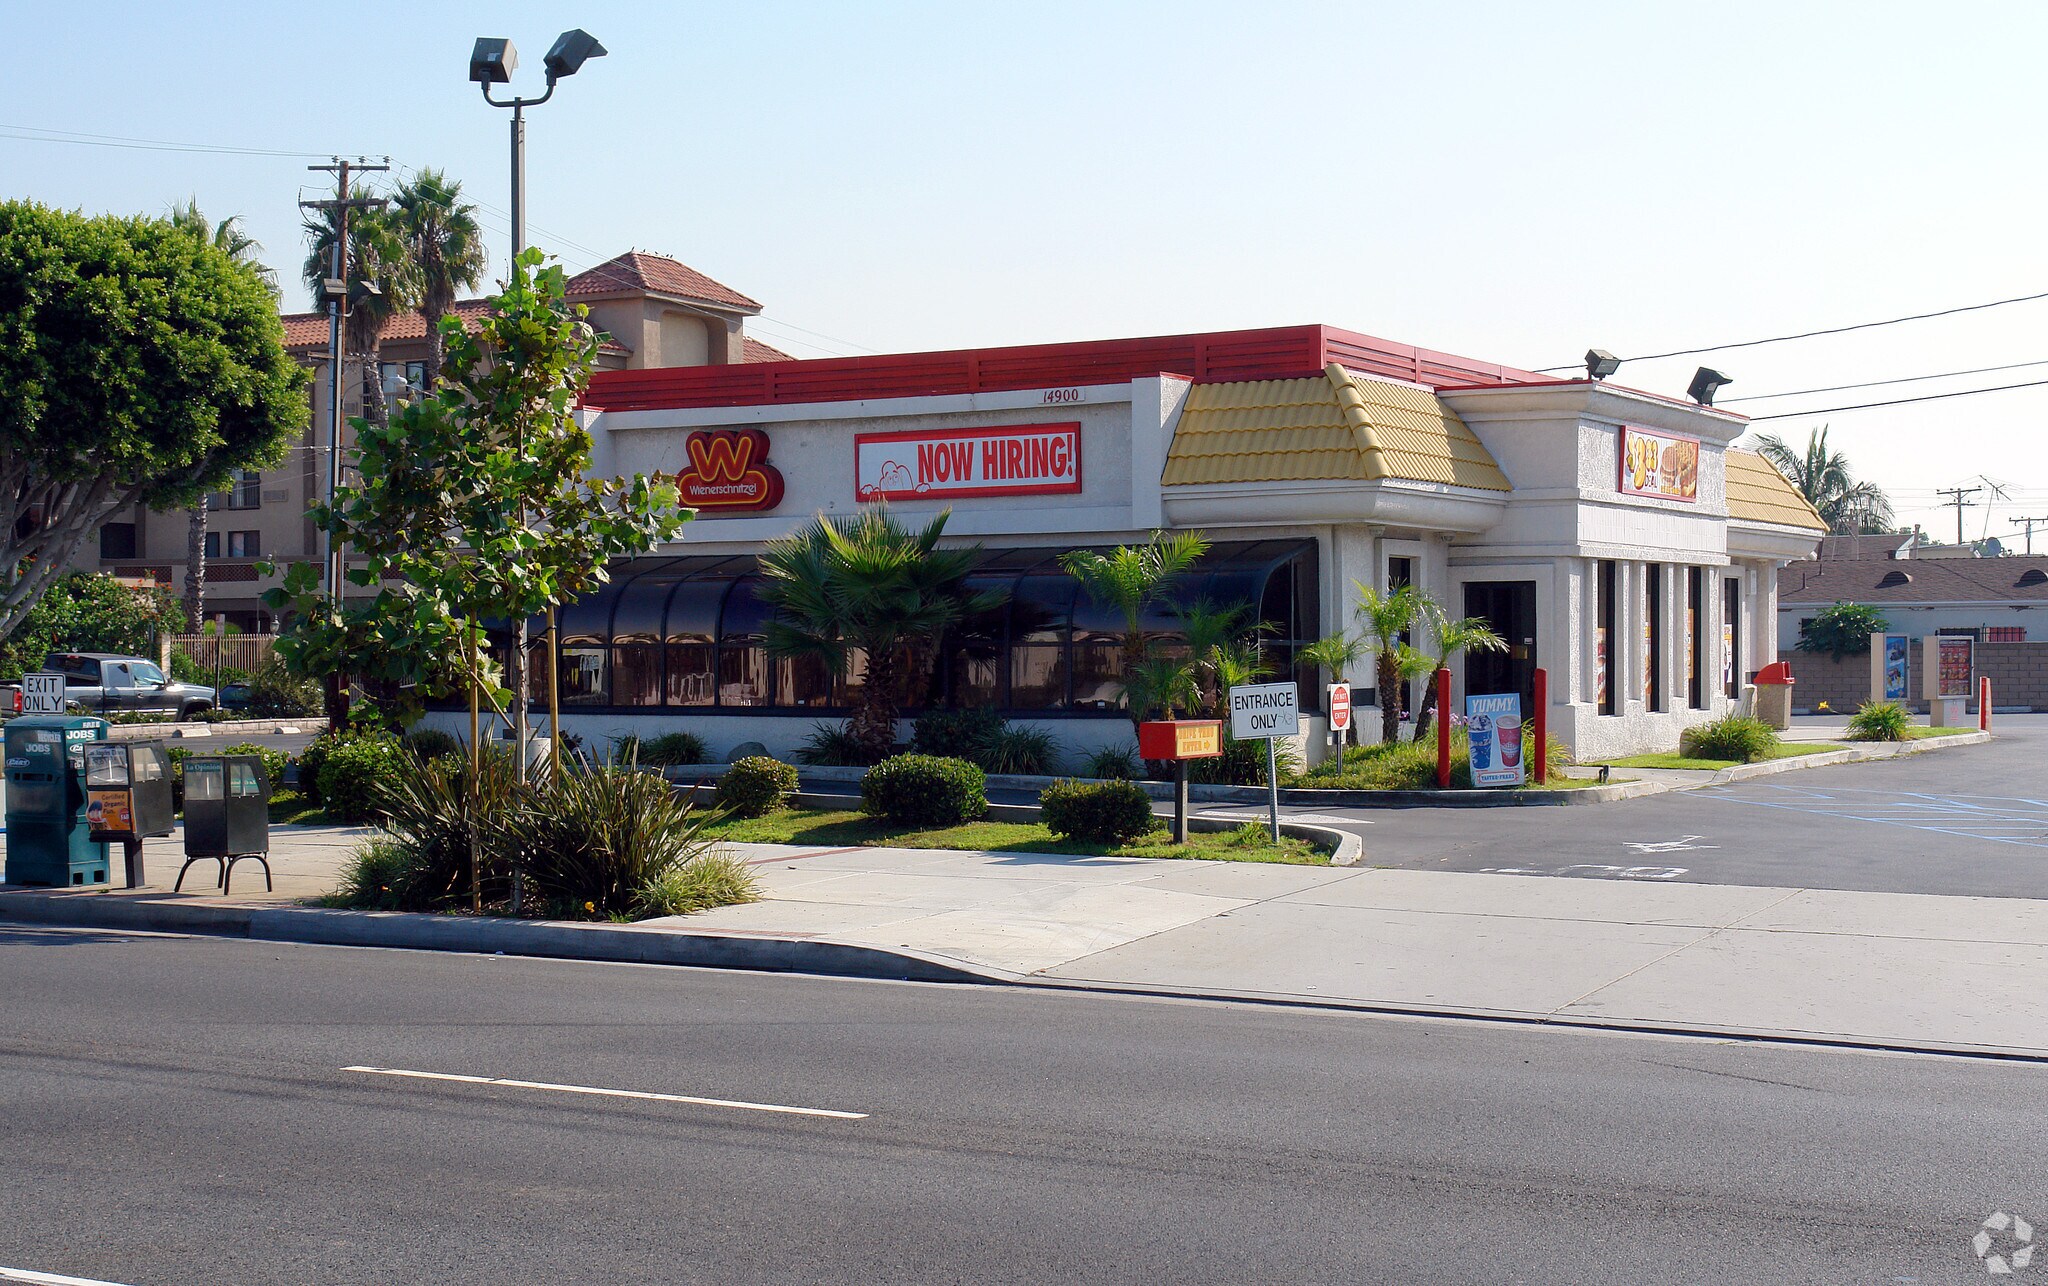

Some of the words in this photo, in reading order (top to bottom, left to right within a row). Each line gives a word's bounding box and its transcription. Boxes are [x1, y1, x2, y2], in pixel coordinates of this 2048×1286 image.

[1043, 388, 1079, 403] 14900
[690, 436, 752, 482] W
[917, 441, 974, 483] NOW
[982, 434, 1073, 480] HIRING!
[689, 483, 757, 496] Wienerschnitzel
[27, 677, 58, 693] EXIT
[24, 695, 62, 711] ONLY
[1234, 691, 1294, 711] ENTRANCE
[1472, 697, 1516, 713] YUMMY!
[1250, 713, 1278, 730] ONLY
[66, 730, 95, 740] JOBS
[26, 744, 50, 753] JOBS
[1183, 741, 1202, 752] ENTER
